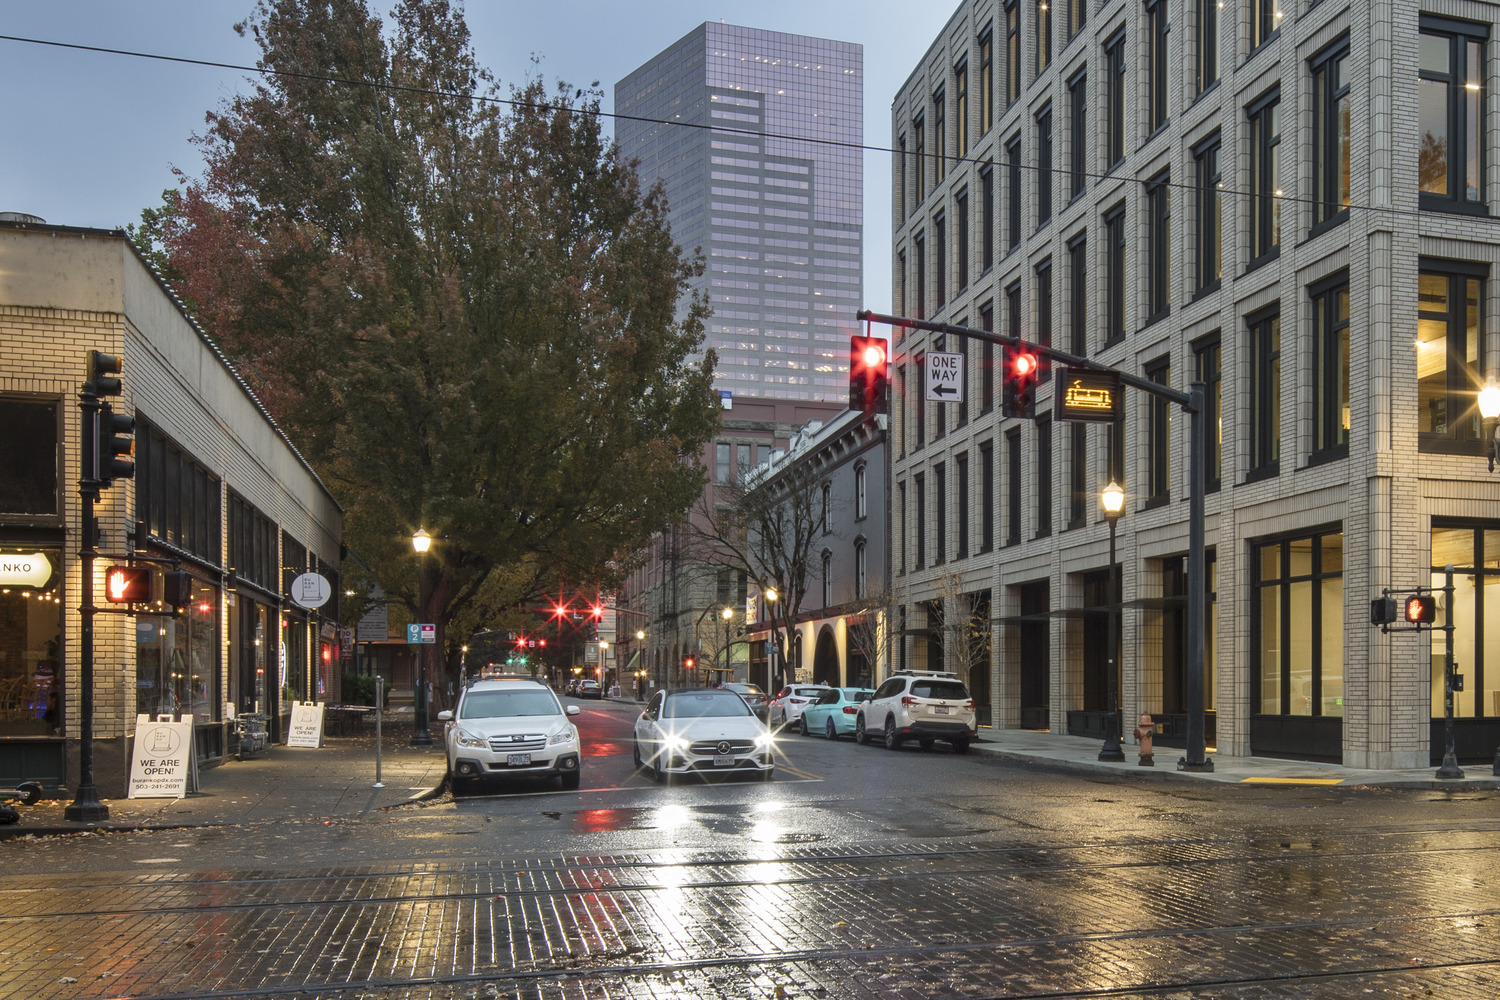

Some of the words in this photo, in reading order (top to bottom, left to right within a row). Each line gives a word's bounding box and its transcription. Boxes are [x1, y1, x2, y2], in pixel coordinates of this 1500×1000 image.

[932, 356, 957, 368] ONE
[931, 369, 958, 381] WAY
[0, 563, 32, 572] NKO
[140, 759, 156, 767] WE
[159, 759, 180, 767] ARE
